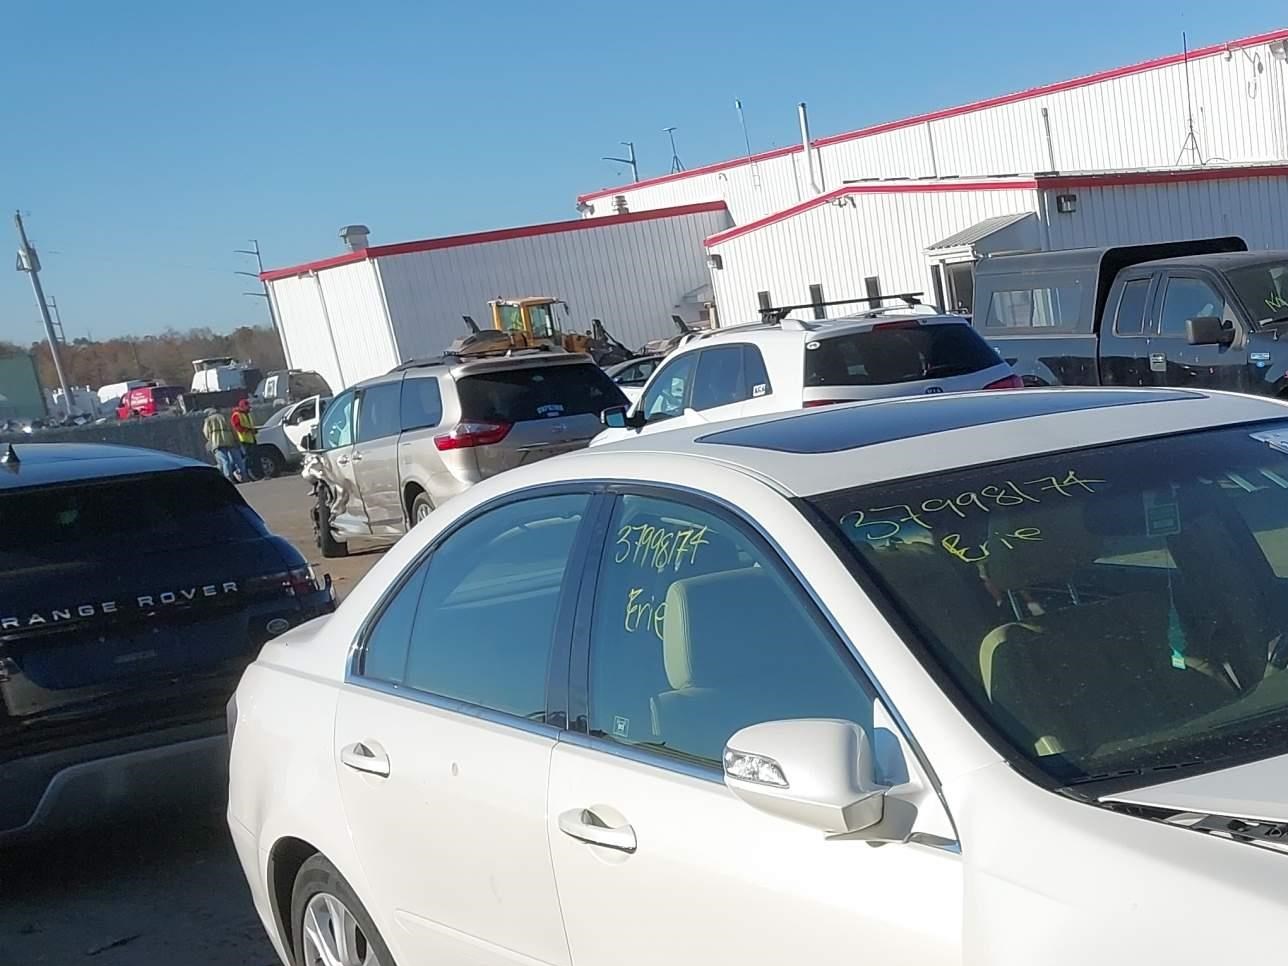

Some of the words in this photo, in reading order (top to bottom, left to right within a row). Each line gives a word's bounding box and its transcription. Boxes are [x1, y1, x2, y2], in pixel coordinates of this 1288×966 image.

[839, 470, 1106, 540] 37998174
[615, 523, 710, 572] 37998174
[1, 601, 118, 629] RANGE
[137, 581, 238, 608] ROVER
